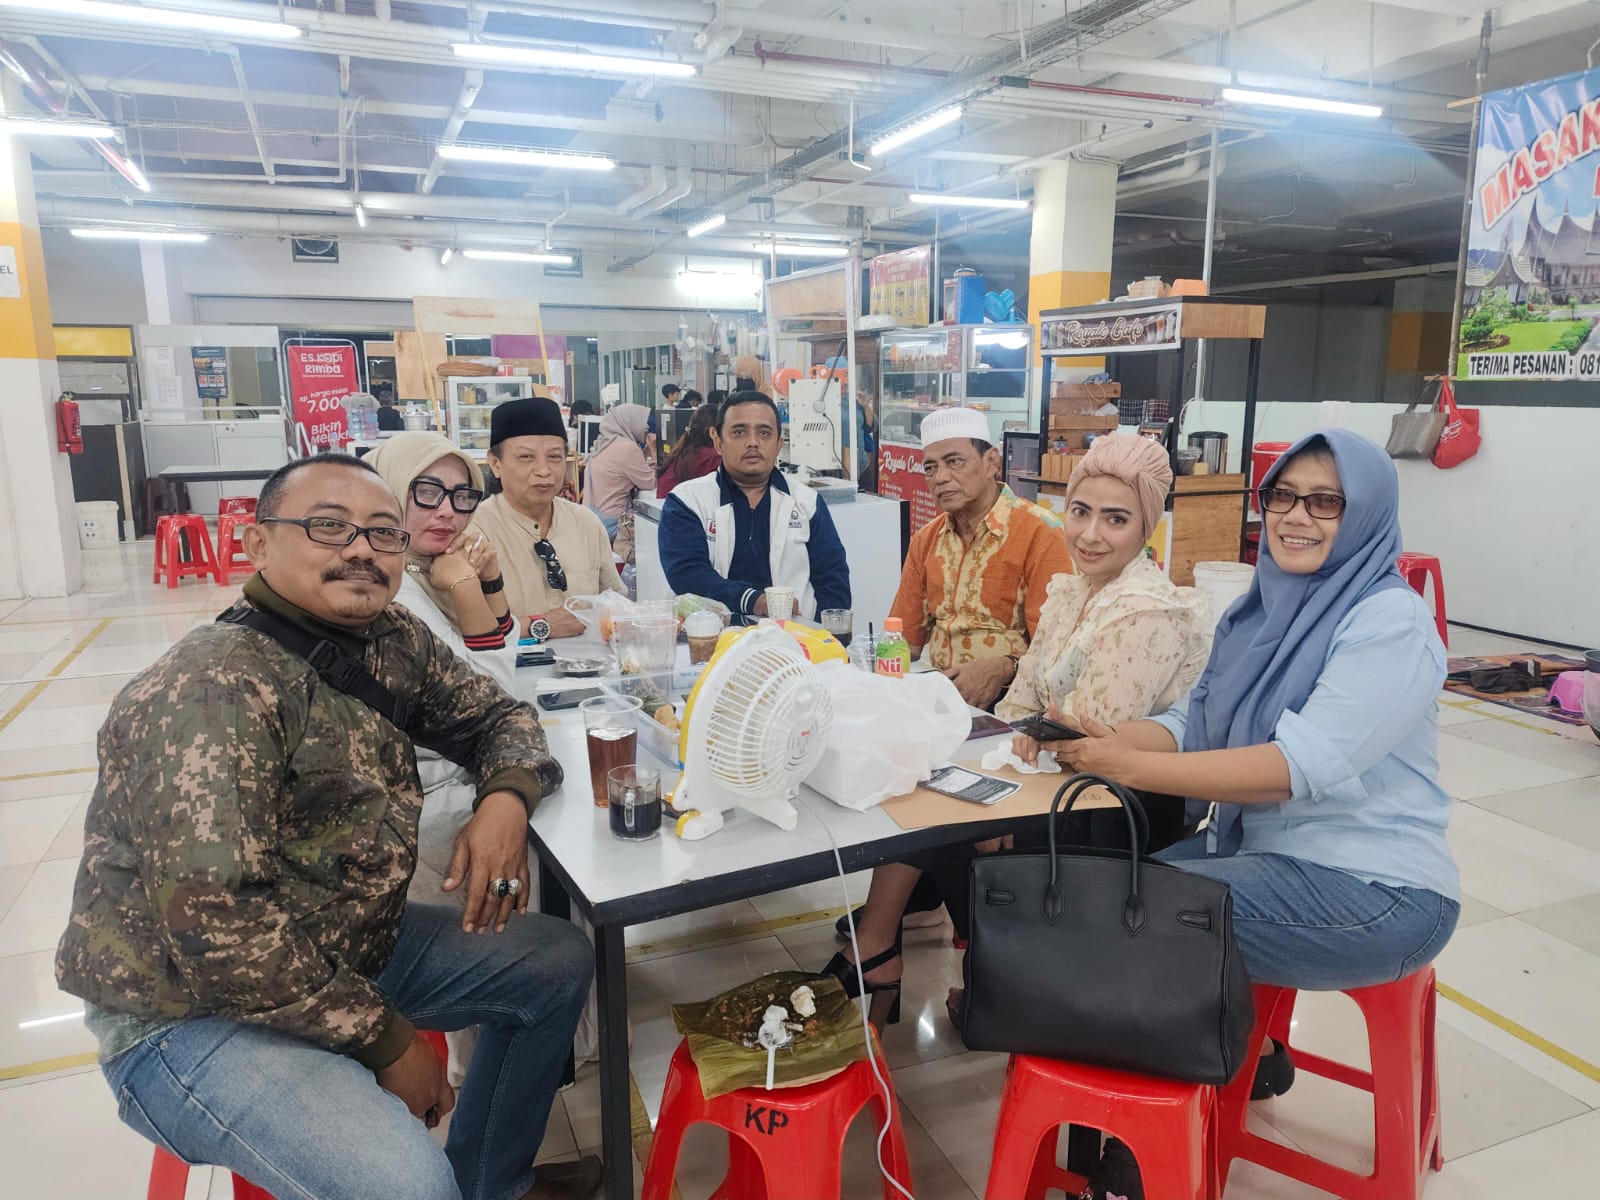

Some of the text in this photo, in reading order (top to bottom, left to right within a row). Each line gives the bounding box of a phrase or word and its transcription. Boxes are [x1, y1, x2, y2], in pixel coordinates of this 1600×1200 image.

[1065, 316, 1144, 347] Royale Cafe
[305, 364, 341, 374] Rimba
[1470, 355, 1510, 376] TERIMA
[1512, 354, 1567, 375] PESANAN
[311, 421, 342, 435] Bikin
[745, 1103, 789, 1135] KP
